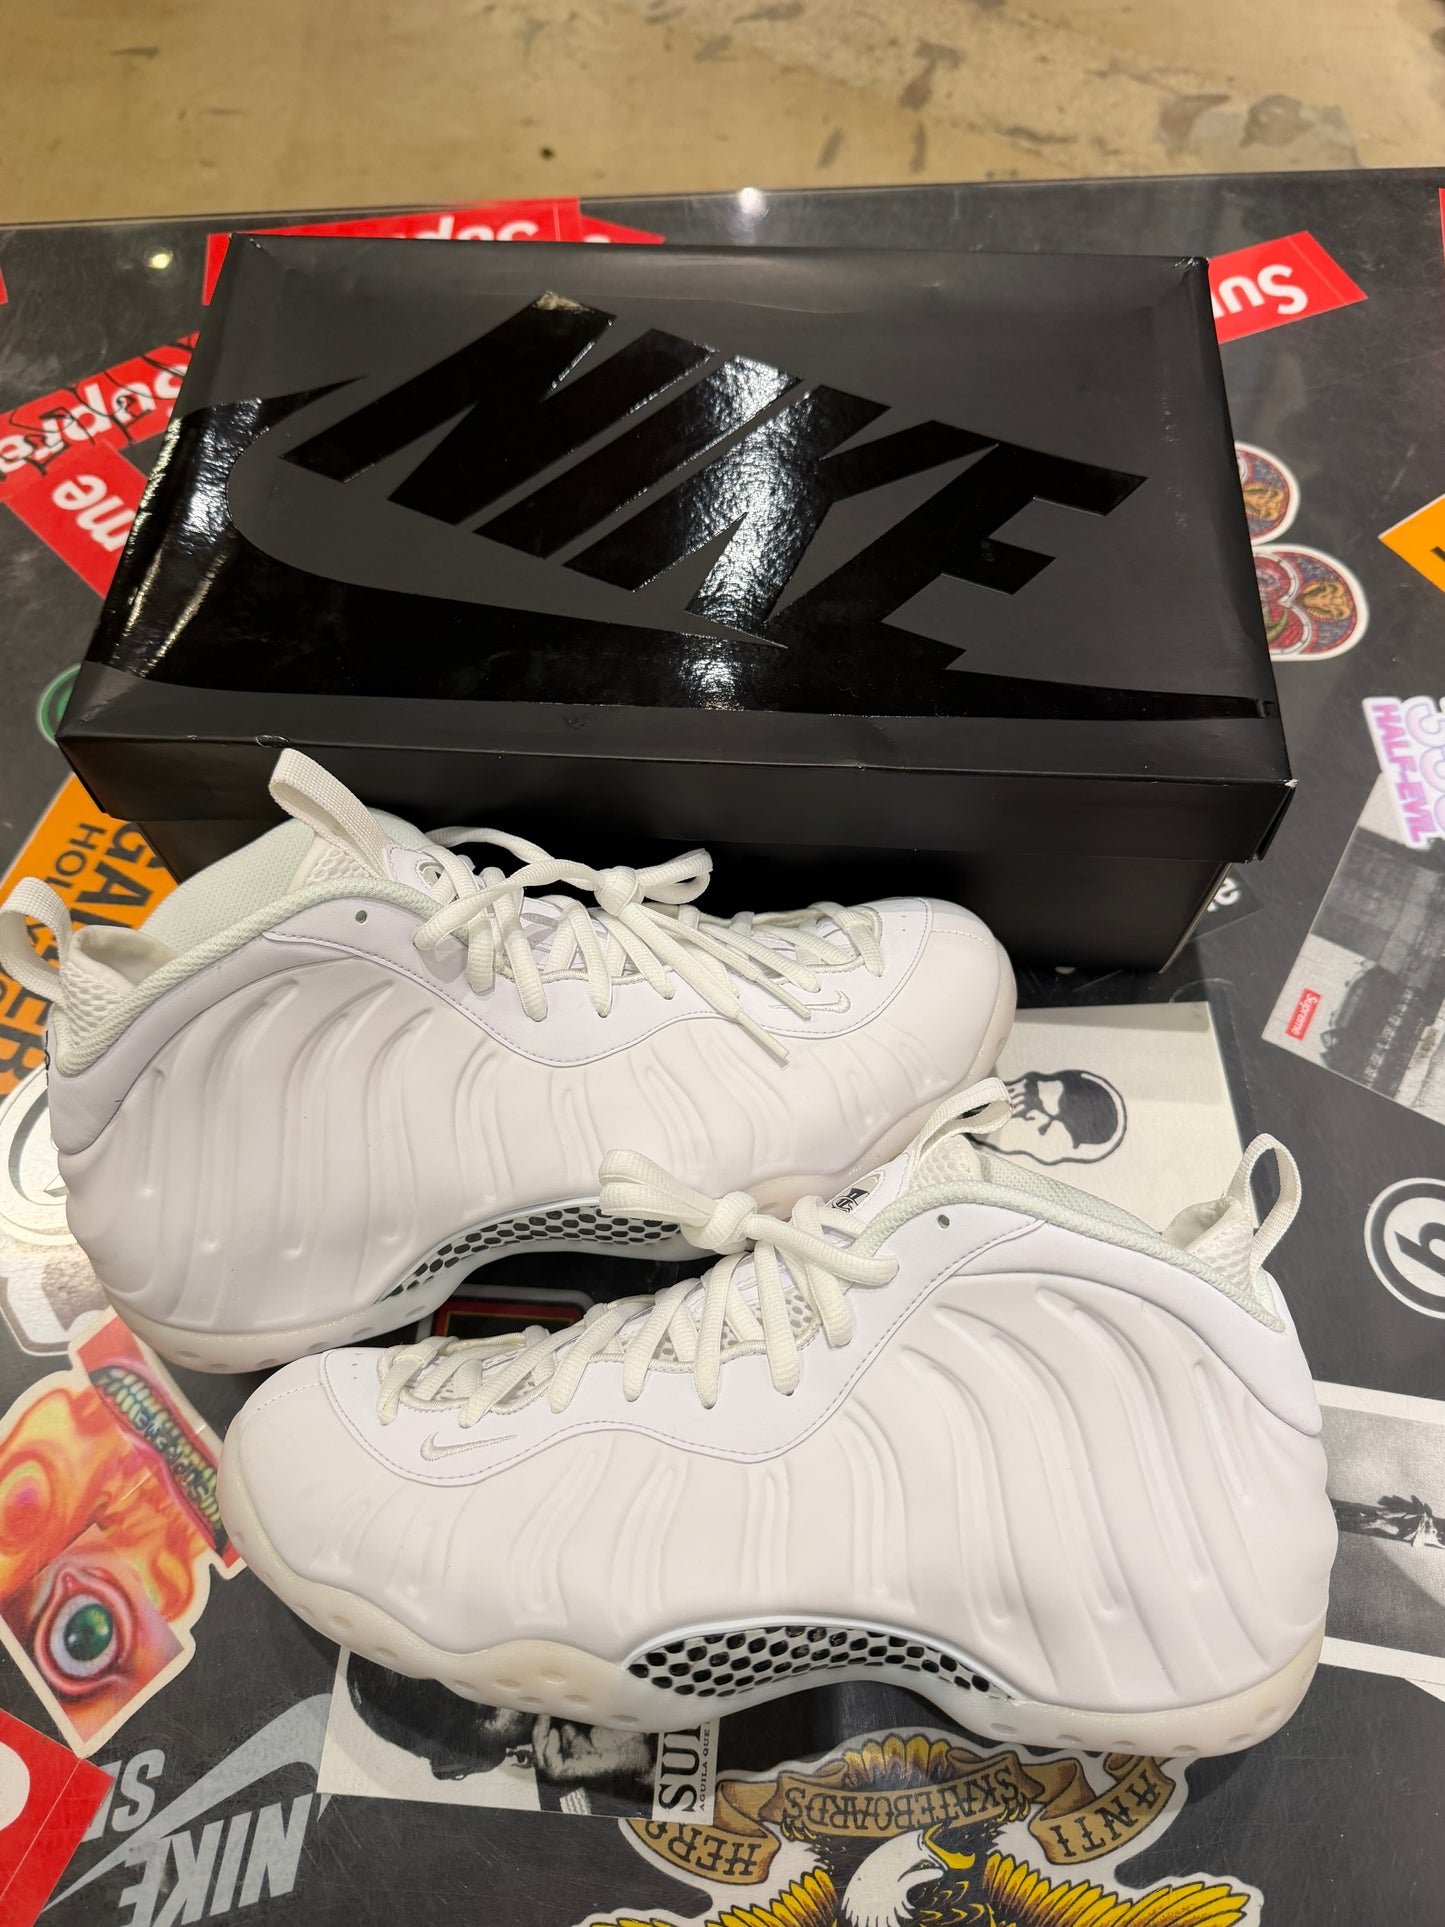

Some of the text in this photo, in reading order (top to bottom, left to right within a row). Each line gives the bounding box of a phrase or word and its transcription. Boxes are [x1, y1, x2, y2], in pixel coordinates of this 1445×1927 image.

[279, 291, 1147, 670] NIKE
[1372, 704, 1435, 843] HALF-EVIL
[1291, 992, 1318, 1035] Supreme
[703, 1728, 711, 1757] QUE
[700, 1760, 708, 1811] AGUILA
[785, 1764, 1019, 1831] SKATEBOARDS
[1048, 1770, 1162, 1858] ANTI
[118, 1792, 314, 1927] NIKE
